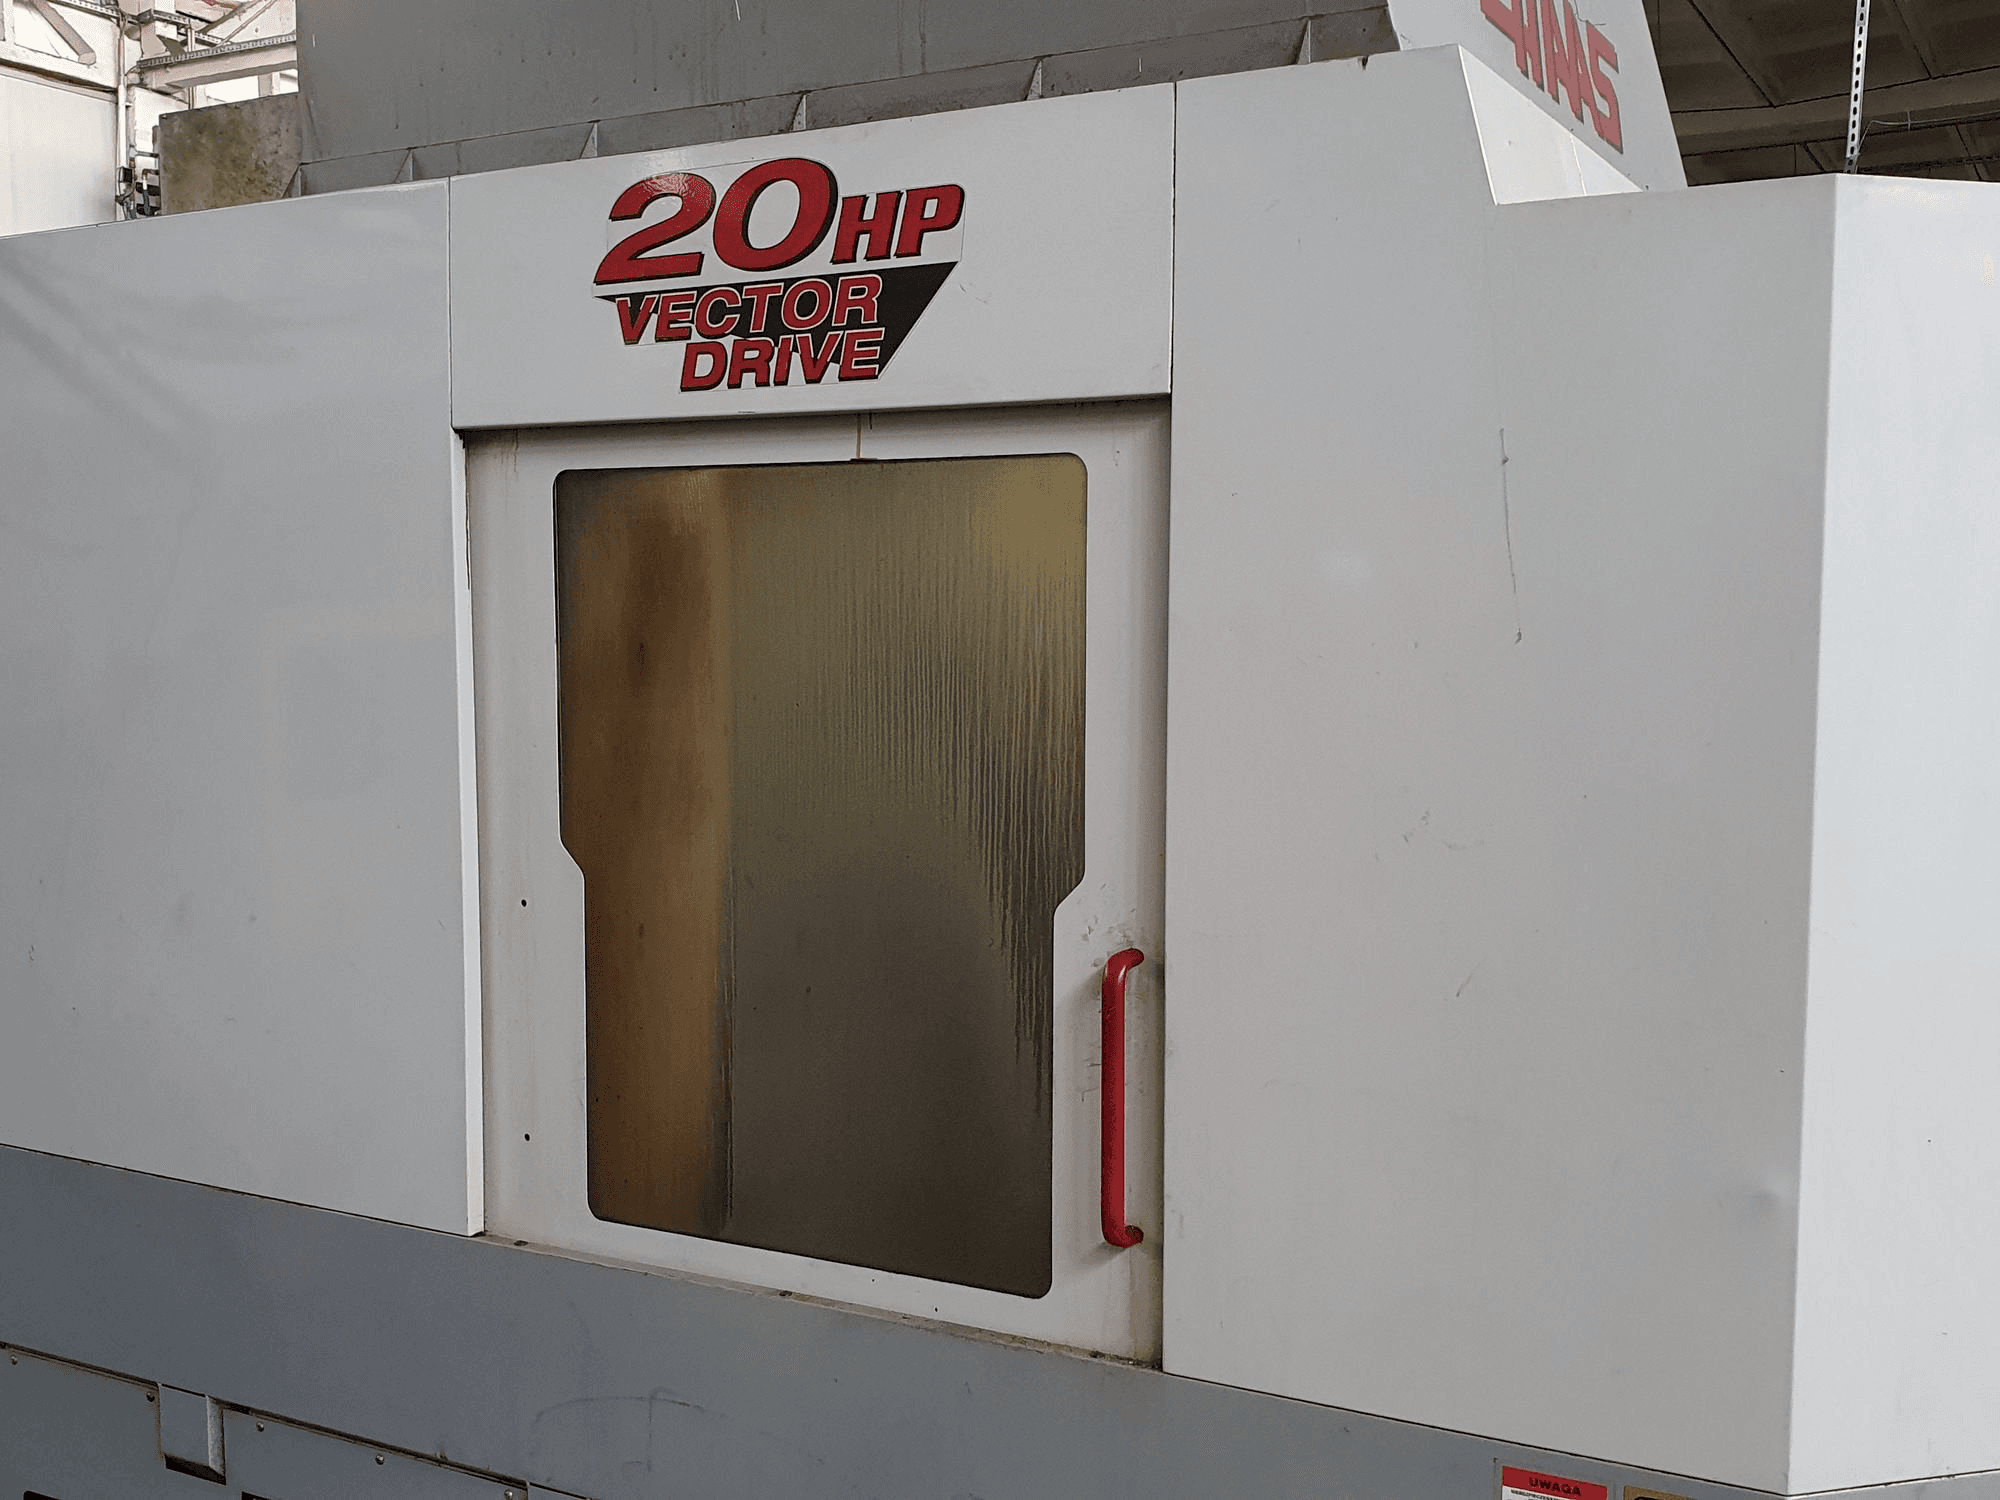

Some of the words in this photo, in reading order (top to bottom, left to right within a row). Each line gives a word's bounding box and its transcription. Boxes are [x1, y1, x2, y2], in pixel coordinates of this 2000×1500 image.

[615, 275, 884, 346] VECTOR
[680, 328, 886, 393] DRIVE
[1529, 1477, 1582, 1497] UWAGA
